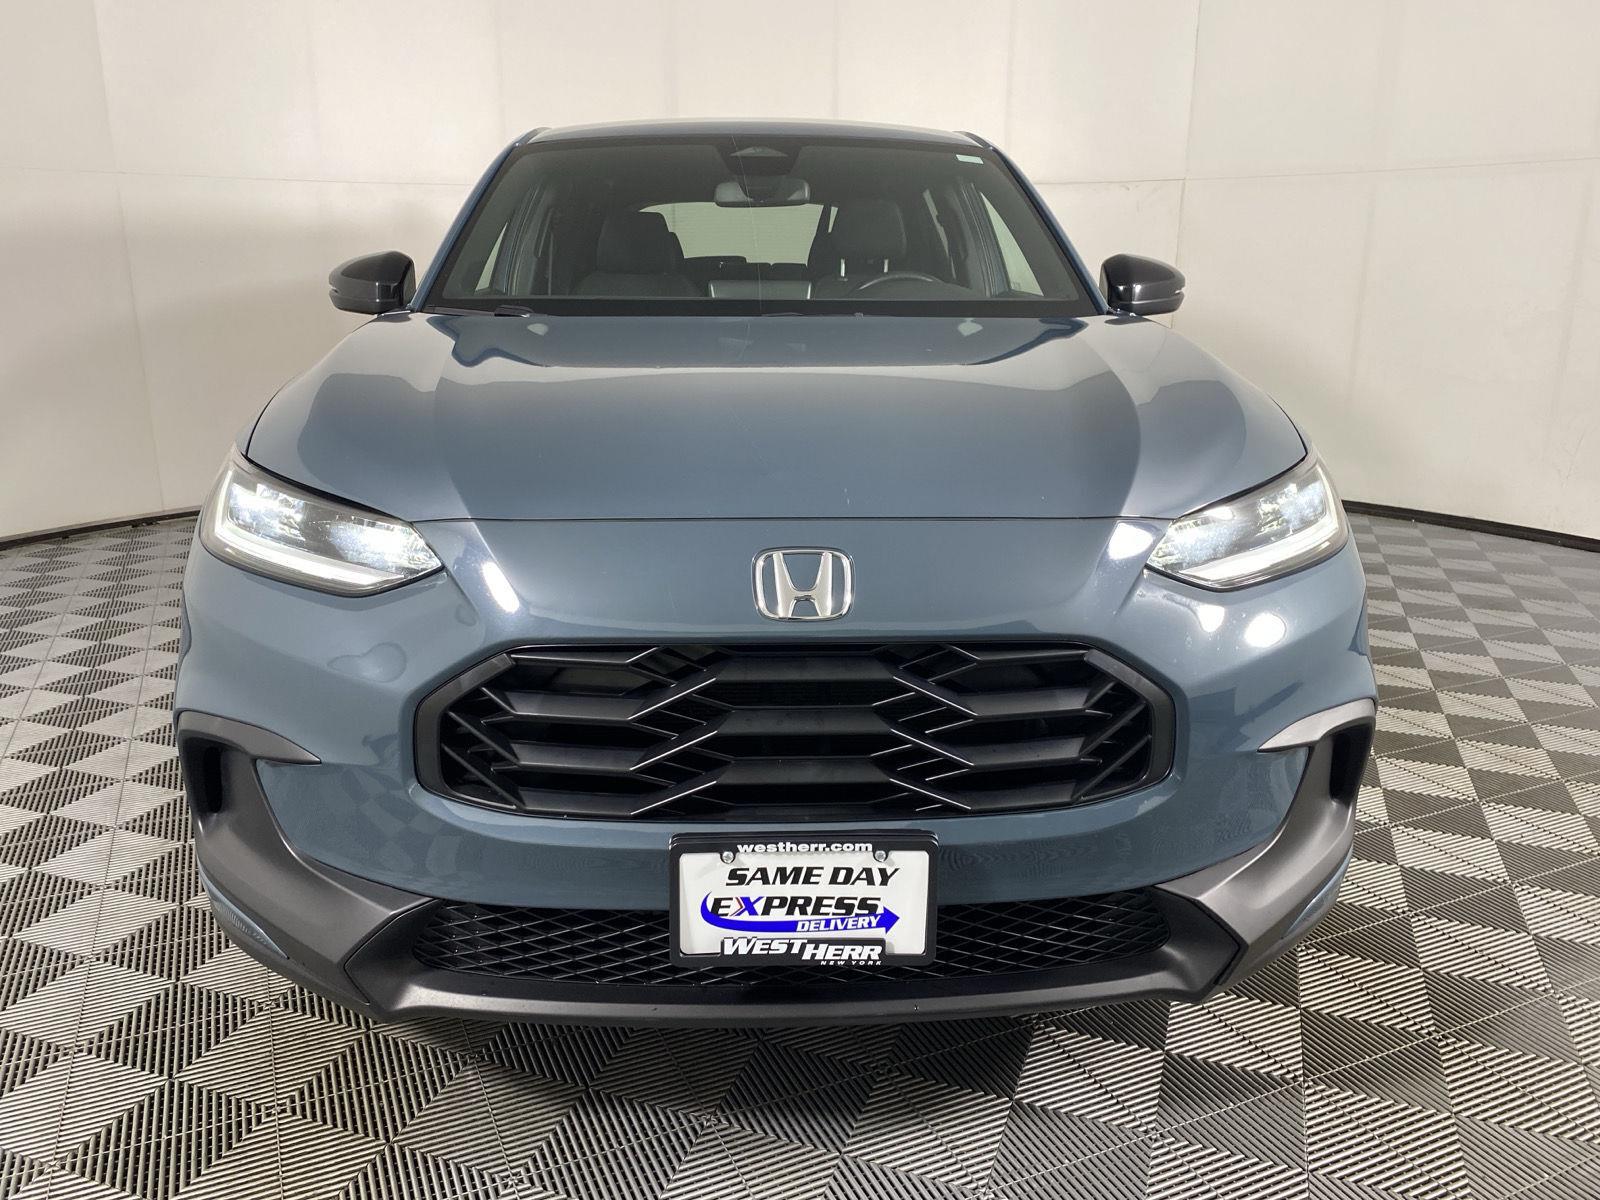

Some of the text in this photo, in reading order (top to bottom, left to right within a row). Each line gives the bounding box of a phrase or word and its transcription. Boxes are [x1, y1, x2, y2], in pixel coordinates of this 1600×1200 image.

[736, 841, 873, 853] westherr.com
[725, 866, 900, 887] SAME DAY
[711, 895, 882, 917] EXPRESS
[795, 914, 882, 933] DELIVERY
